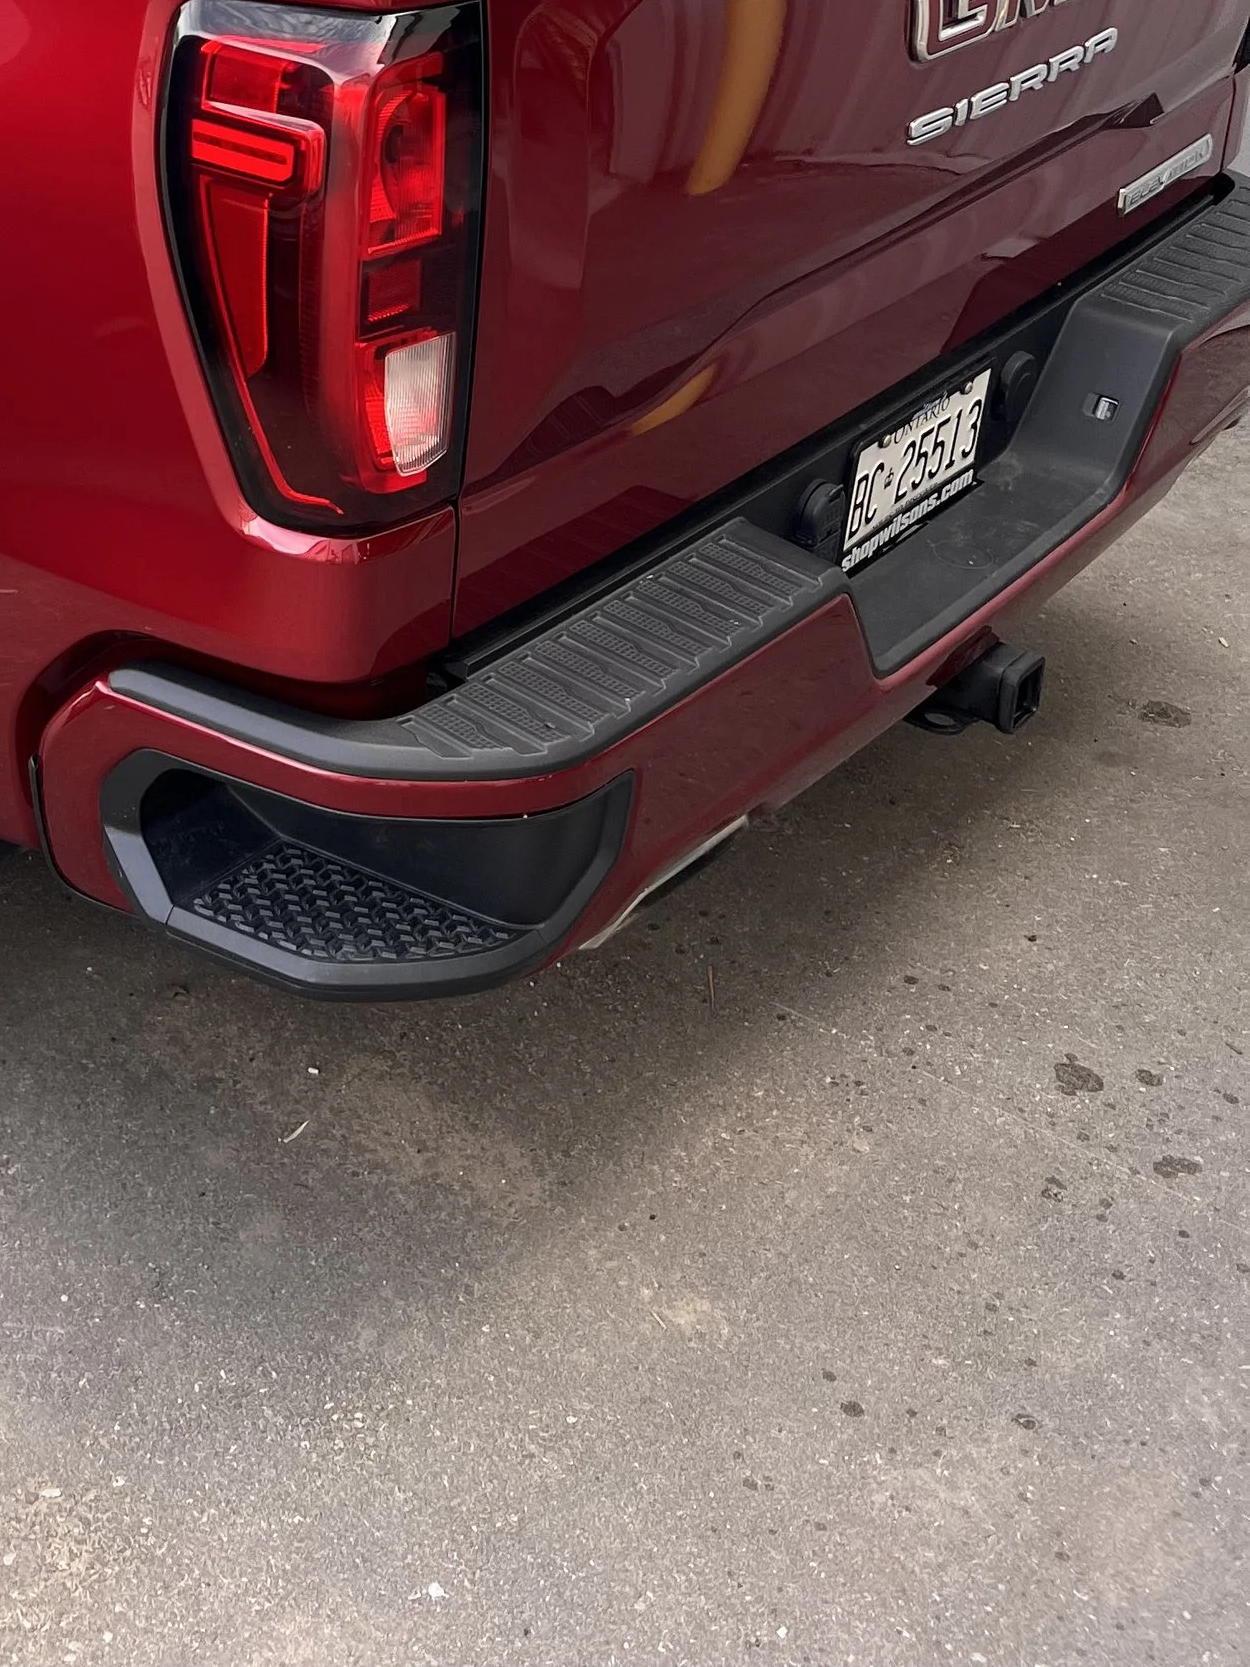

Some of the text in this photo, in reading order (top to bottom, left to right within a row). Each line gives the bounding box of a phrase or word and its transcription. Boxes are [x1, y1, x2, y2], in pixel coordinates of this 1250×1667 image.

[906, 27, 1118, 146] SIERRA
[842, 469, 975, 572] shopwilsons.com
[848, 462, 885, 542] BC
[894, 399, 982, 504] 25513
